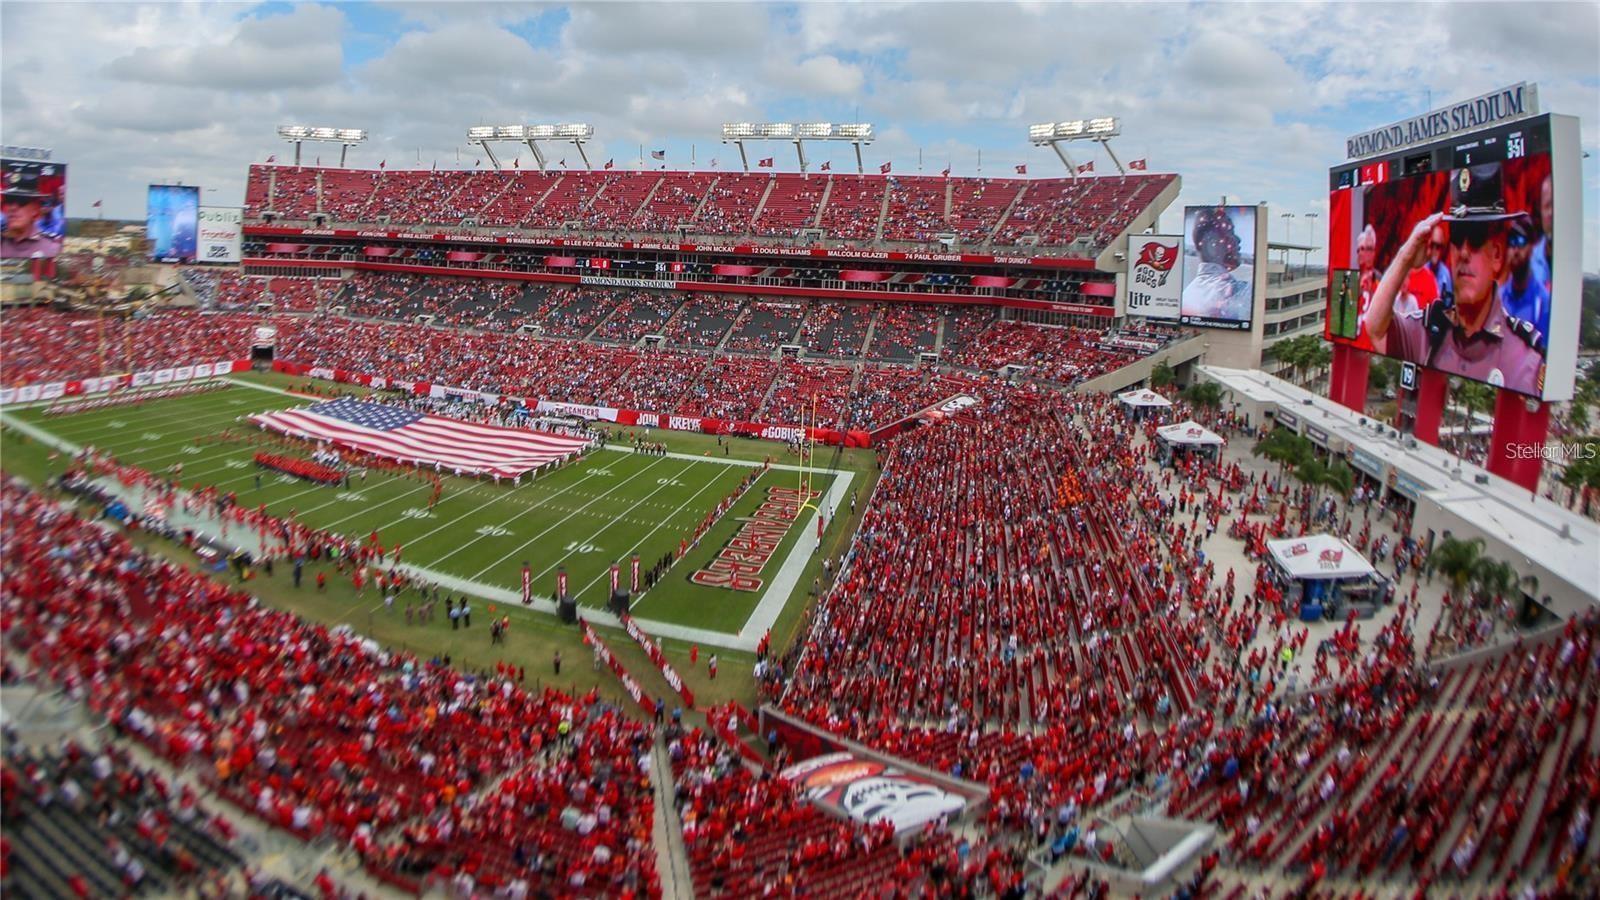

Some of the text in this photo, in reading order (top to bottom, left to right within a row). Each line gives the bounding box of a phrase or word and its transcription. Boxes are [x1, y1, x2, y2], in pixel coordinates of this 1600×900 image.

[1346, 86, 1524, 159] RAYMOND JAMES STADIUM
[595, 241, 619, 249] SELMON
[662, 243, 680, 251] GILES
[760, 247, 779, 255] DOUG
[779, 248, 812, 256] WILLIAMS
[827, 250, 889, 260] MALCOLM GLAZER
[904, 252, 962, 262] 74 PAUL GRUBER
[993, 256, 1008, 264] TONY
[581, 277, 675, 289] RAYMOND JAMES STADIUM
[1136, 273, 1157, 288] BUCS
[1129, 291, 1151, 309] Lite
[1403, 367, 1413, 384] 19
[637, 412, 659, 426] JOIN
